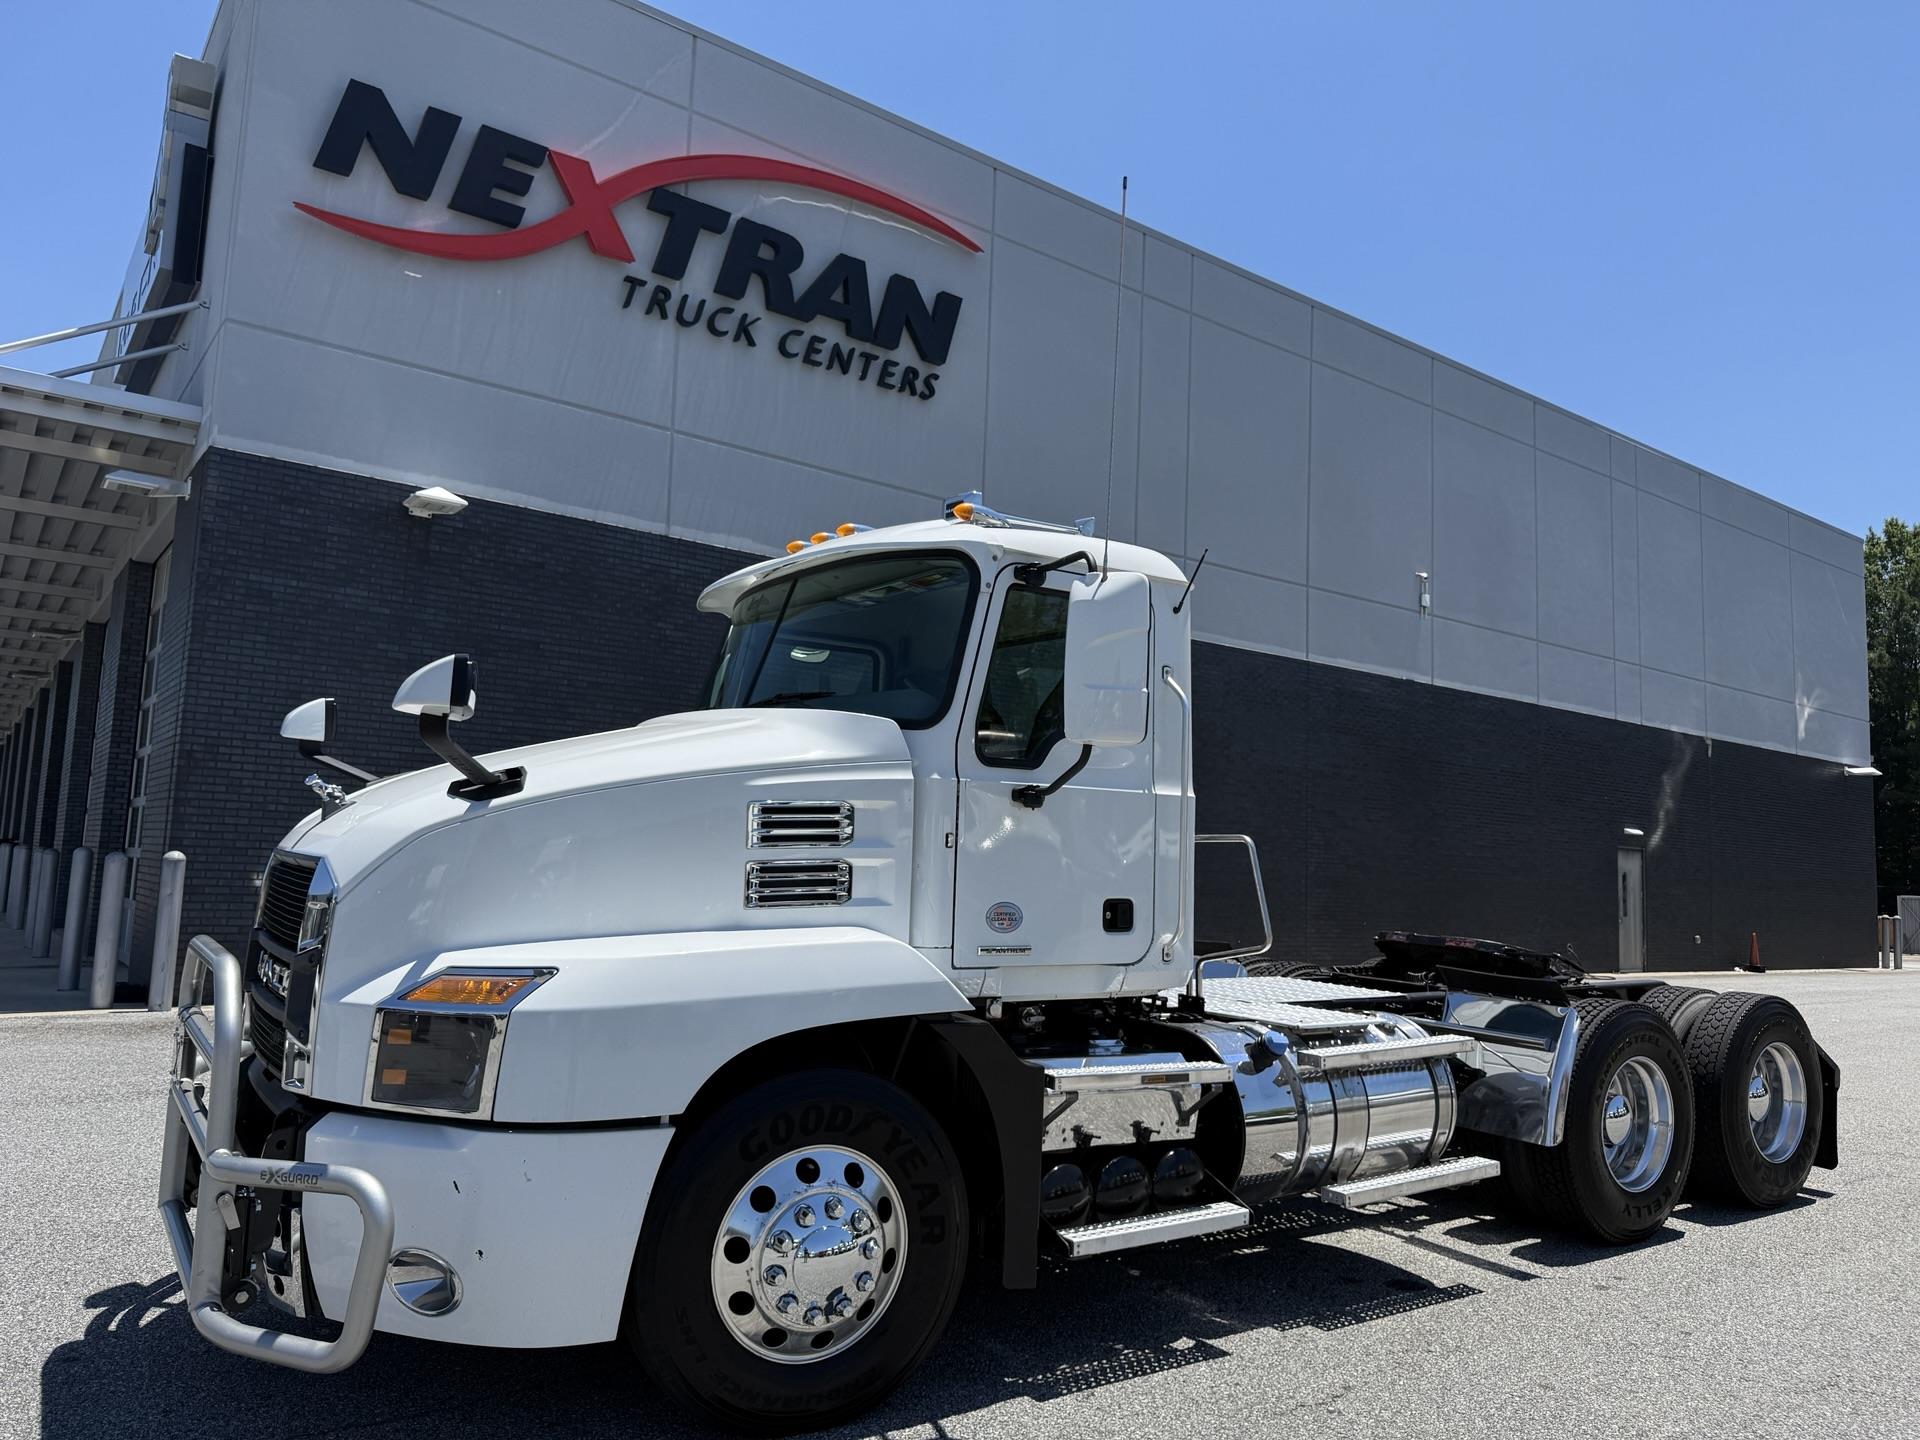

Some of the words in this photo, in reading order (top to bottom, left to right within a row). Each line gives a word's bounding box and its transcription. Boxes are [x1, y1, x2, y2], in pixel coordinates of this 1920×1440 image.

[306, 78, 966, 366] NEXTRAN
[621, 274, 760, 348] TRUCK
[778, 328, 940, 401] CENTERS
[737, 1103, 947, 1248] GOODYEAR
[1622, 1184, 1672, 1219] KELLY
